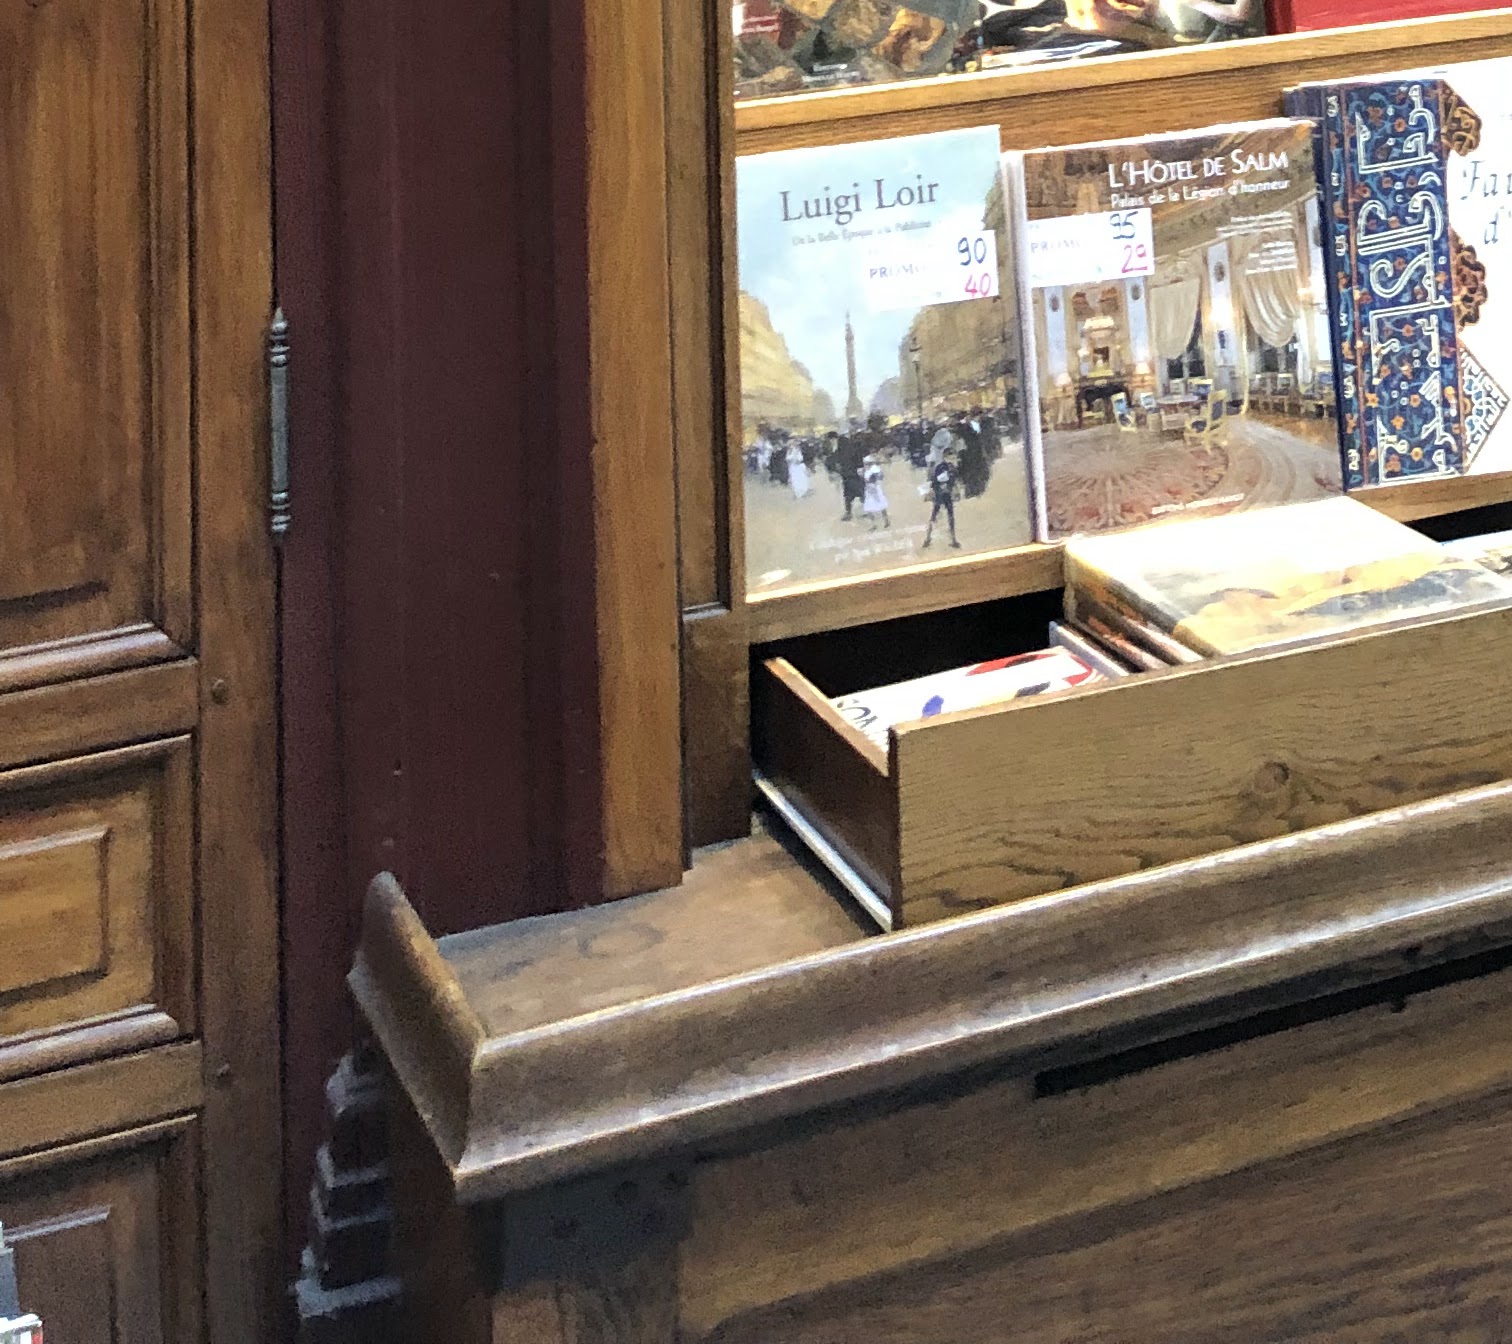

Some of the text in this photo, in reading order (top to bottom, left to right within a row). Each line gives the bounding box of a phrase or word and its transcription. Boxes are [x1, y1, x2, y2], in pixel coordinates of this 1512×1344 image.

[1203, 157, 1227, 177] DE
[779, 173, 939, 226] Luigi Loir
[1149, 189, 1166, 204] de
[1109, 210, 1139, 240] 95
[958, 236, 987, 266] 90
[964, 273, 991, 297] 40
